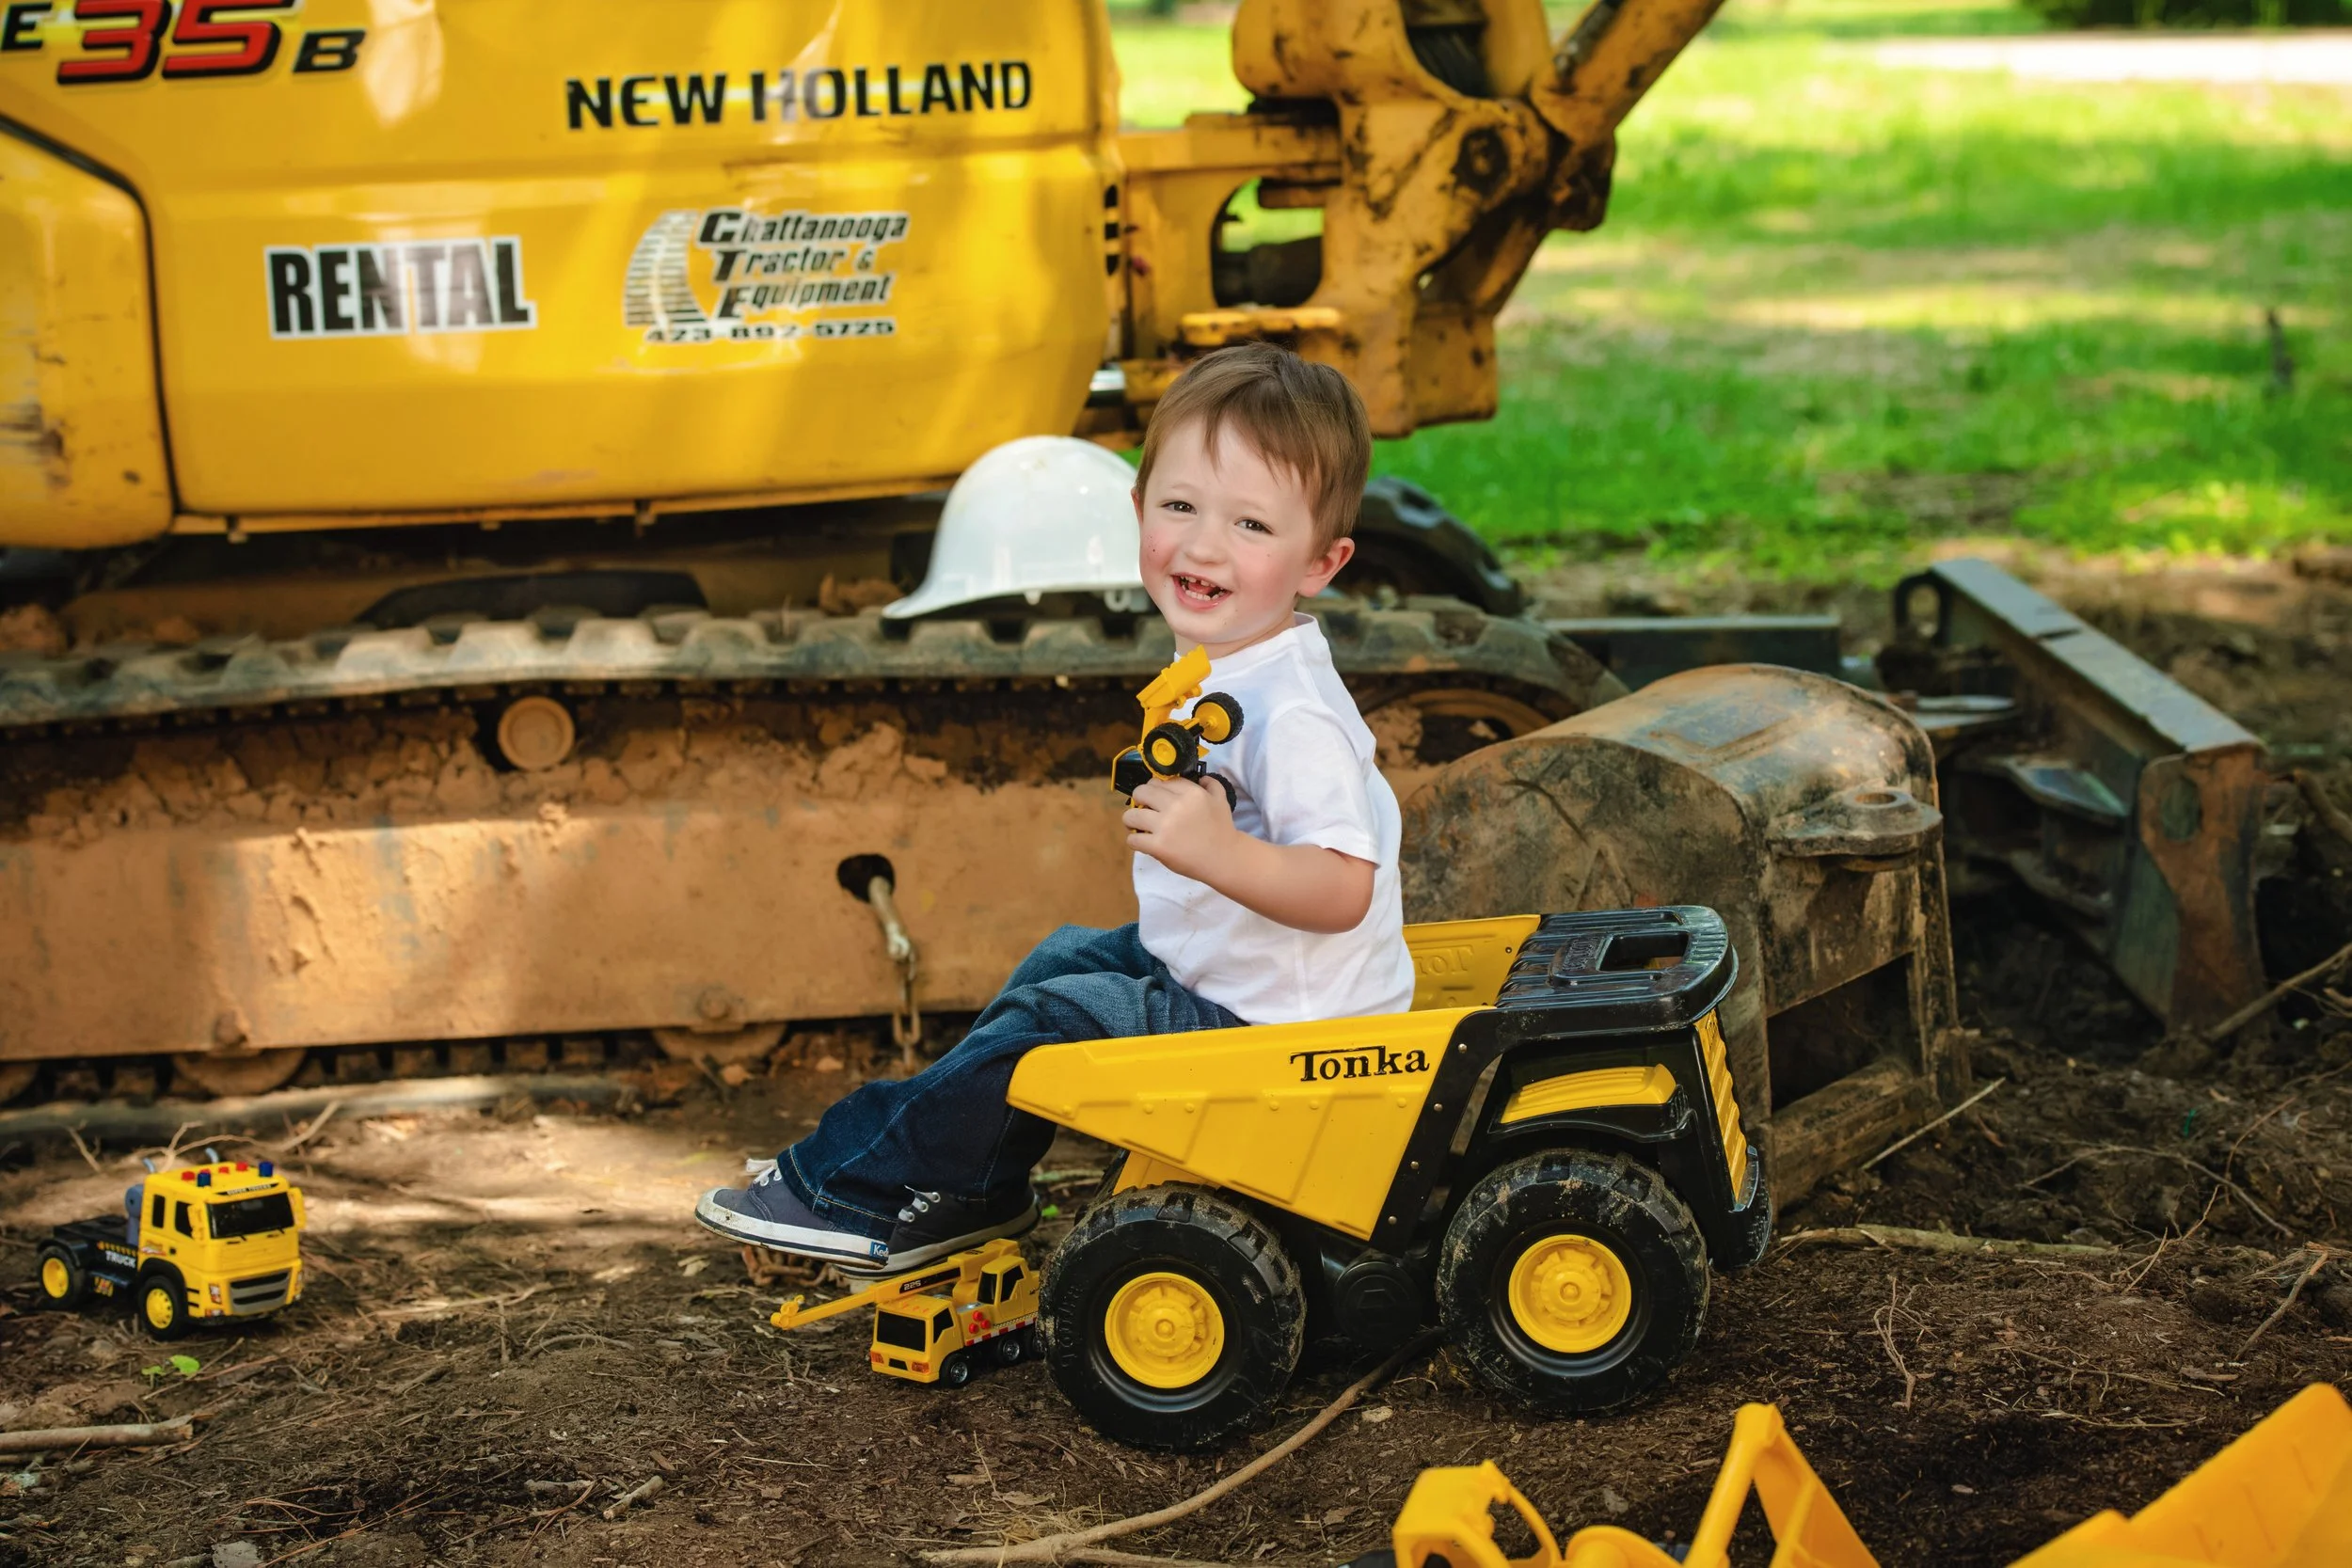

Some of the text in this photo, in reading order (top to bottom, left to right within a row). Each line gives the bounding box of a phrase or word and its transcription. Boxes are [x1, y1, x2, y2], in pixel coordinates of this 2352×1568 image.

[566, 61, 1032, 129] NEW HOLLAND
[700, 212, 909, 243] Chattanooga
[714, 246, 873, 281] Tractor &
[268, 241, 529, 334] RENTAL
[718, 274, 891, 318] Equipment
[1290, 1045, 1430, 1082] Tonka
[105, 1250, 135, 1268] TRUCK
